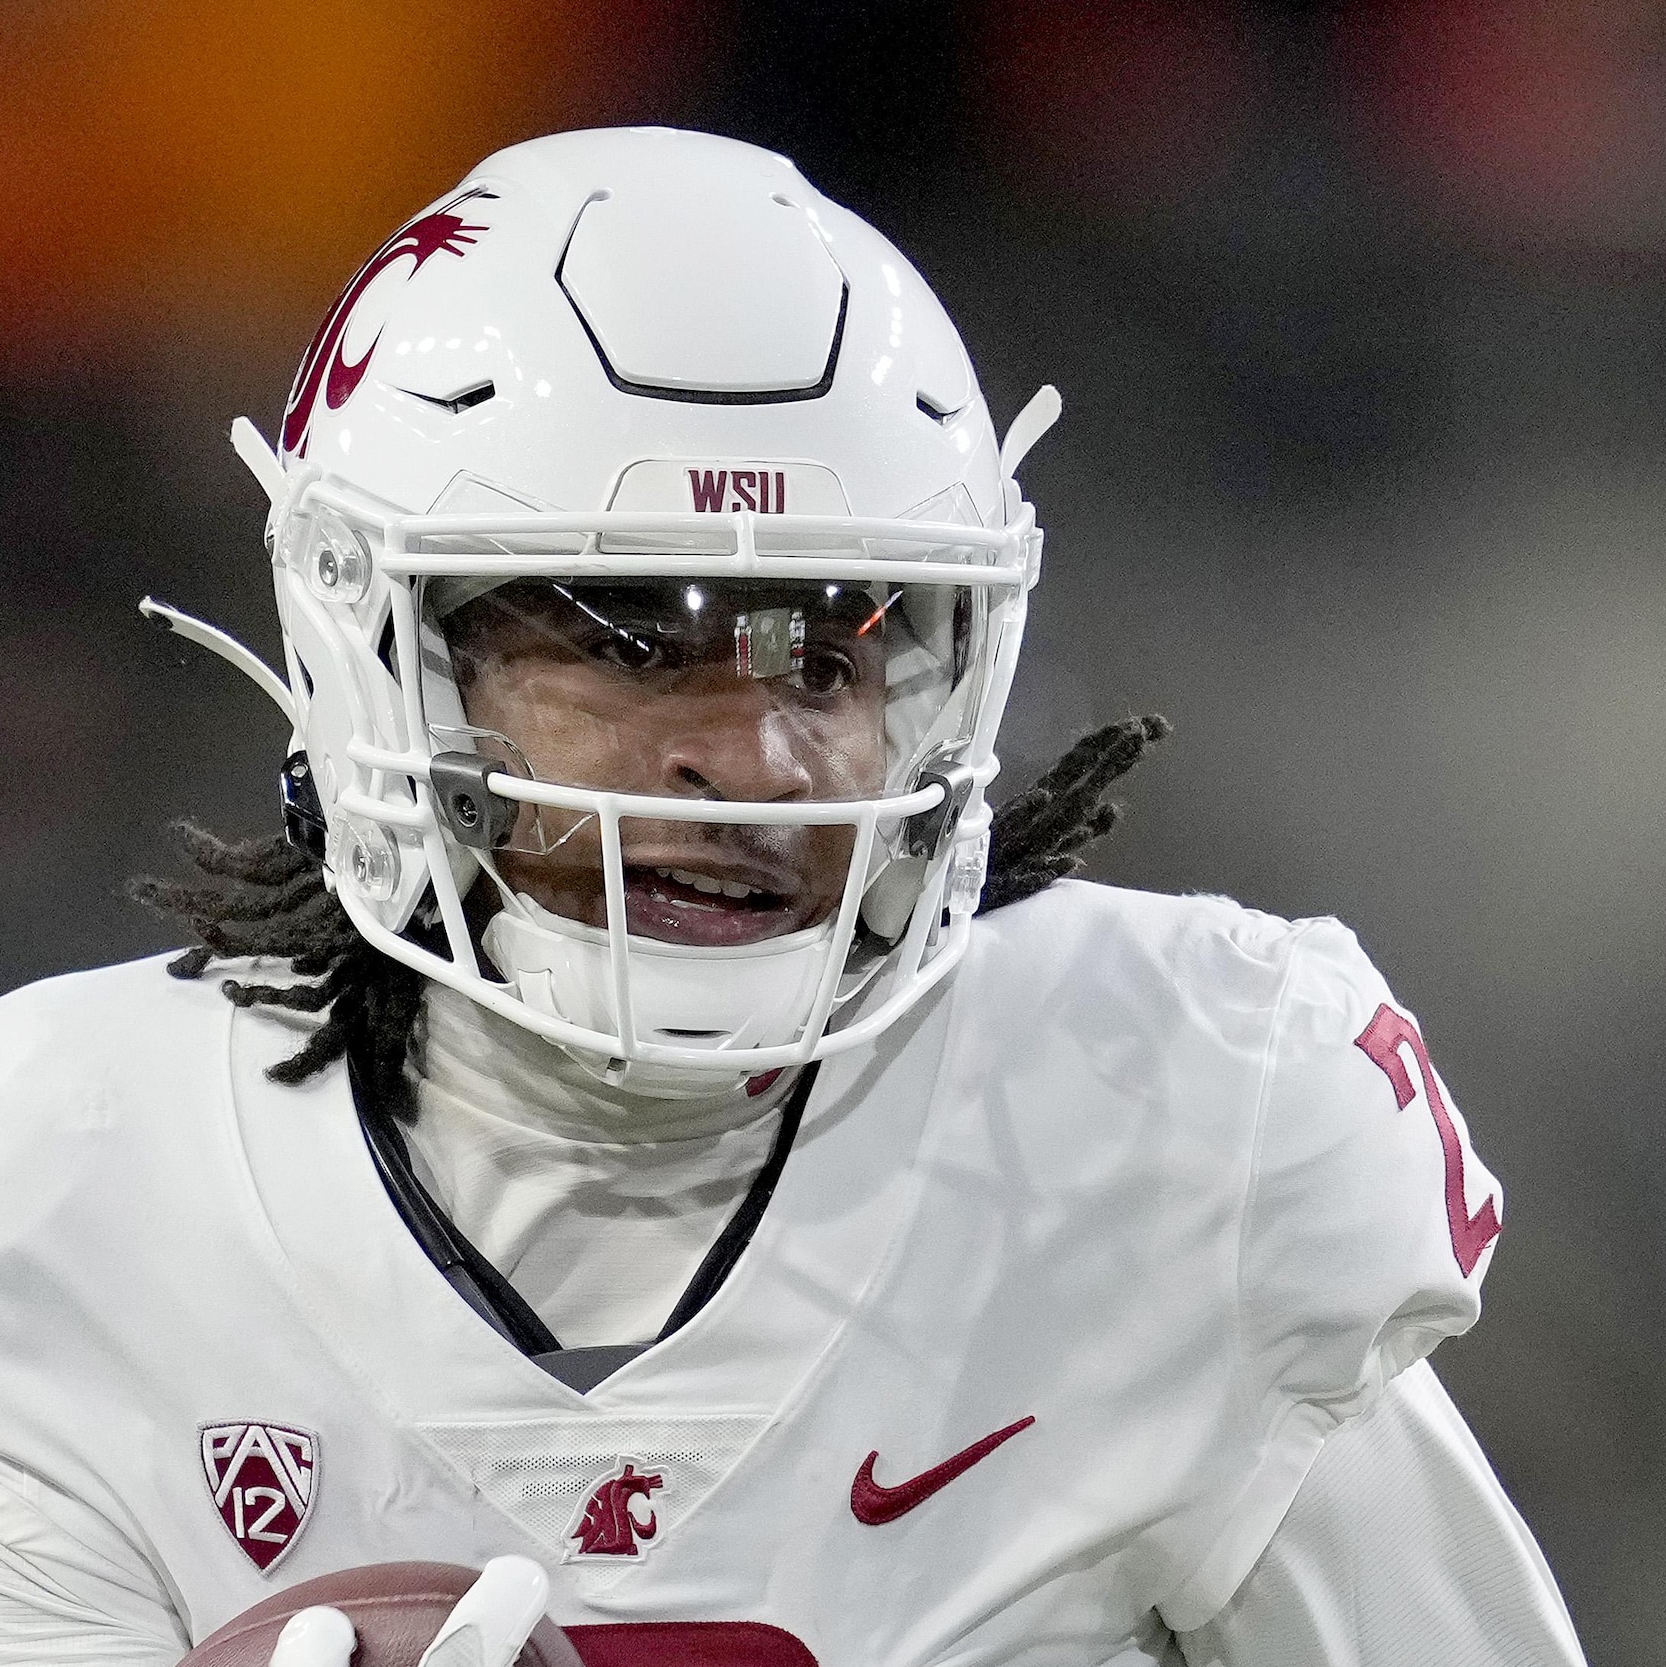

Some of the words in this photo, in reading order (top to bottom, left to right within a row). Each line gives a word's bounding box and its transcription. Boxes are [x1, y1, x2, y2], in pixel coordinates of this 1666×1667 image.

[687, 470, 785, 514] WSU
[1354, 1002, 1503, 1279] 2
[202, 1424, 313, 1520] PAC
[232, 1486, 289, 1545] 12
